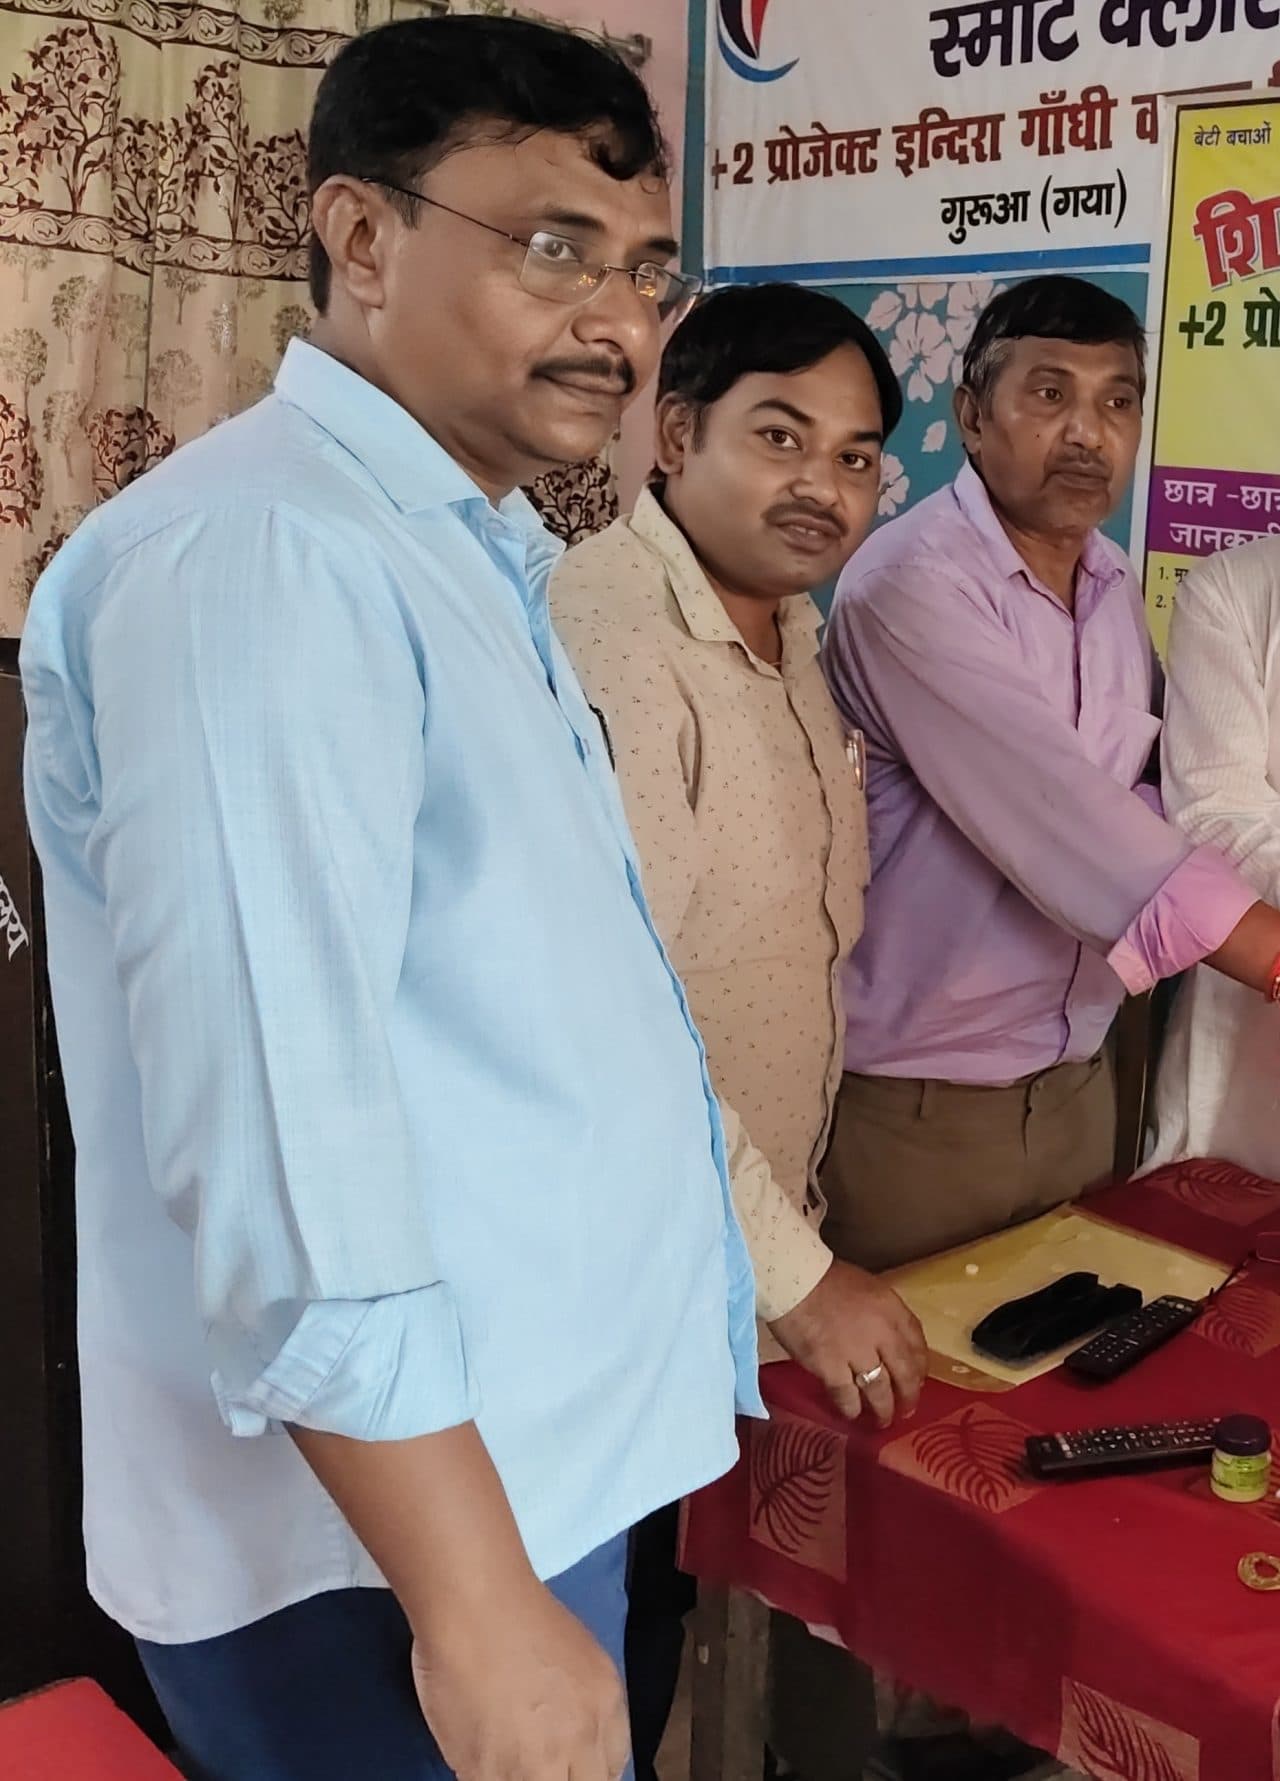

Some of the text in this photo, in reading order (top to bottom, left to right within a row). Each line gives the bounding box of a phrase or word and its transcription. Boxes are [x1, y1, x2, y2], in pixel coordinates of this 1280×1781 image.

[711, 142, 754, 190] +2
[765, 121, 881, 184] प्रोजेक्ट
[892, 107, 1005, 178] इन्दिरा
[1018, 85, 1119, 156] गाँधी
[1194, 124, 1221, 146] बेटी
[1040, 168, 1127, 233] (गया)
[1179, 301, 1226, 349] +2
[1163, 479, 1217, 507] छात्र
[1158, 566, 1169, 580] 1.
[1155, 594, 1167, 608] 2.
